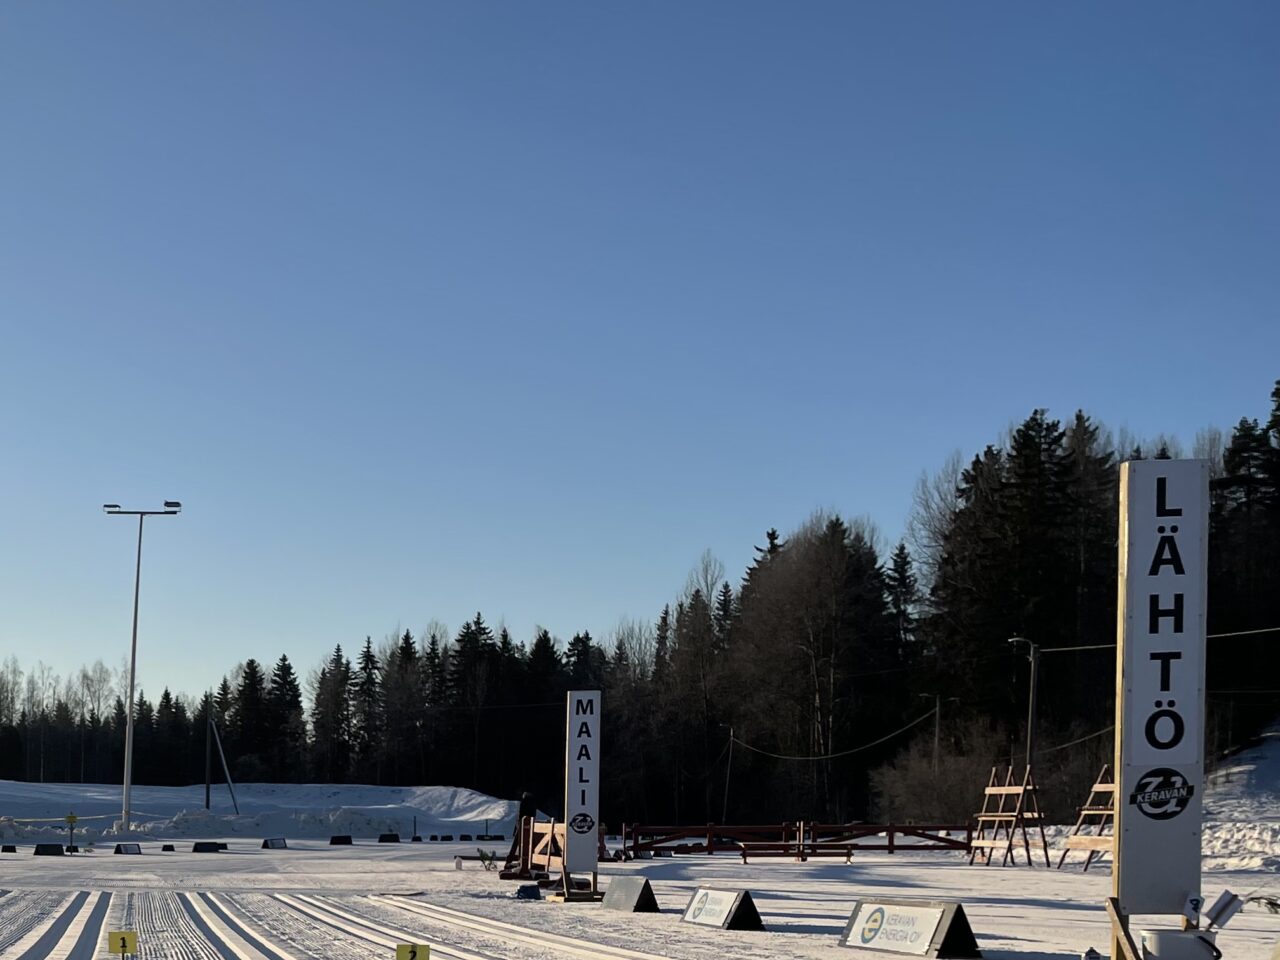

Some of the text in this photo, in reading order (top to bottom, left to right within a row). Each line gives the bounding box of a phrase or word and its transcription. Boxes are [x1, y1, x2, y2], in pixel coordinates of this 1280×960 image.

[1144, 476, 1186, 750] LÄHTÖ
[575, 698, 594, 806] MAALI
[1136, 786, 1188, 803] KERAVAN
[120, 936, 127, 948] 1
